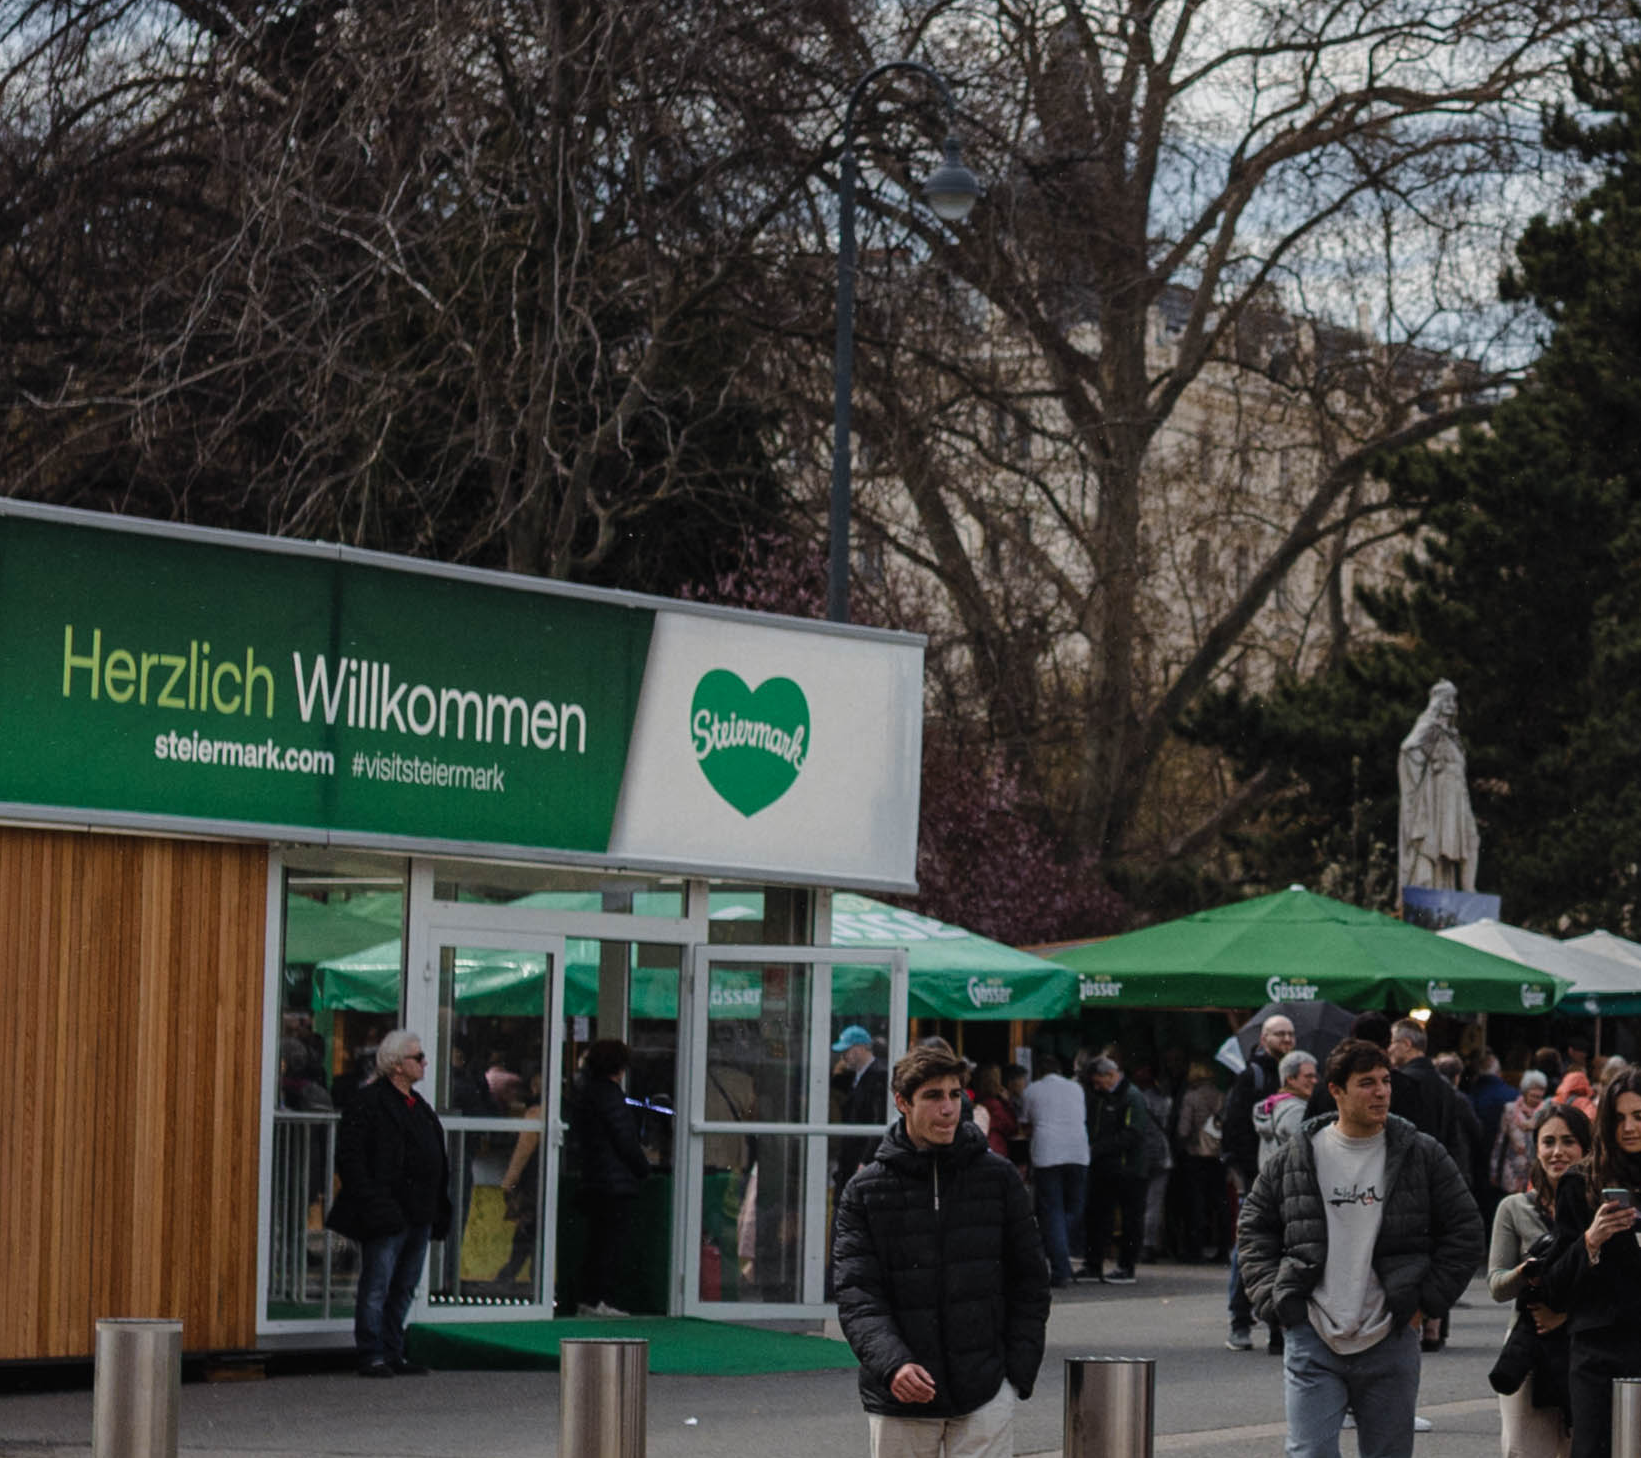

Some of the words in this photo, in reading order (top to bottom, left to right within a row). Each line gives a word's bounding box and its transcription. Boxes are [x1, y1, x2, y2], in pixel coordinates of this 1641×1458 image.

[62, 624, 275, 719] Herzlich
[293, 651, 587, 754] Willkommen
[154, 729, 335, 775] steiermark.com
[351, 750, 505, 792] #visitsteiermark
[693, 708, 806, 772] Steiermark
[967, 976, 1014, 1008] Gösser
[1266, 976, 1318, 1003] Gösser
